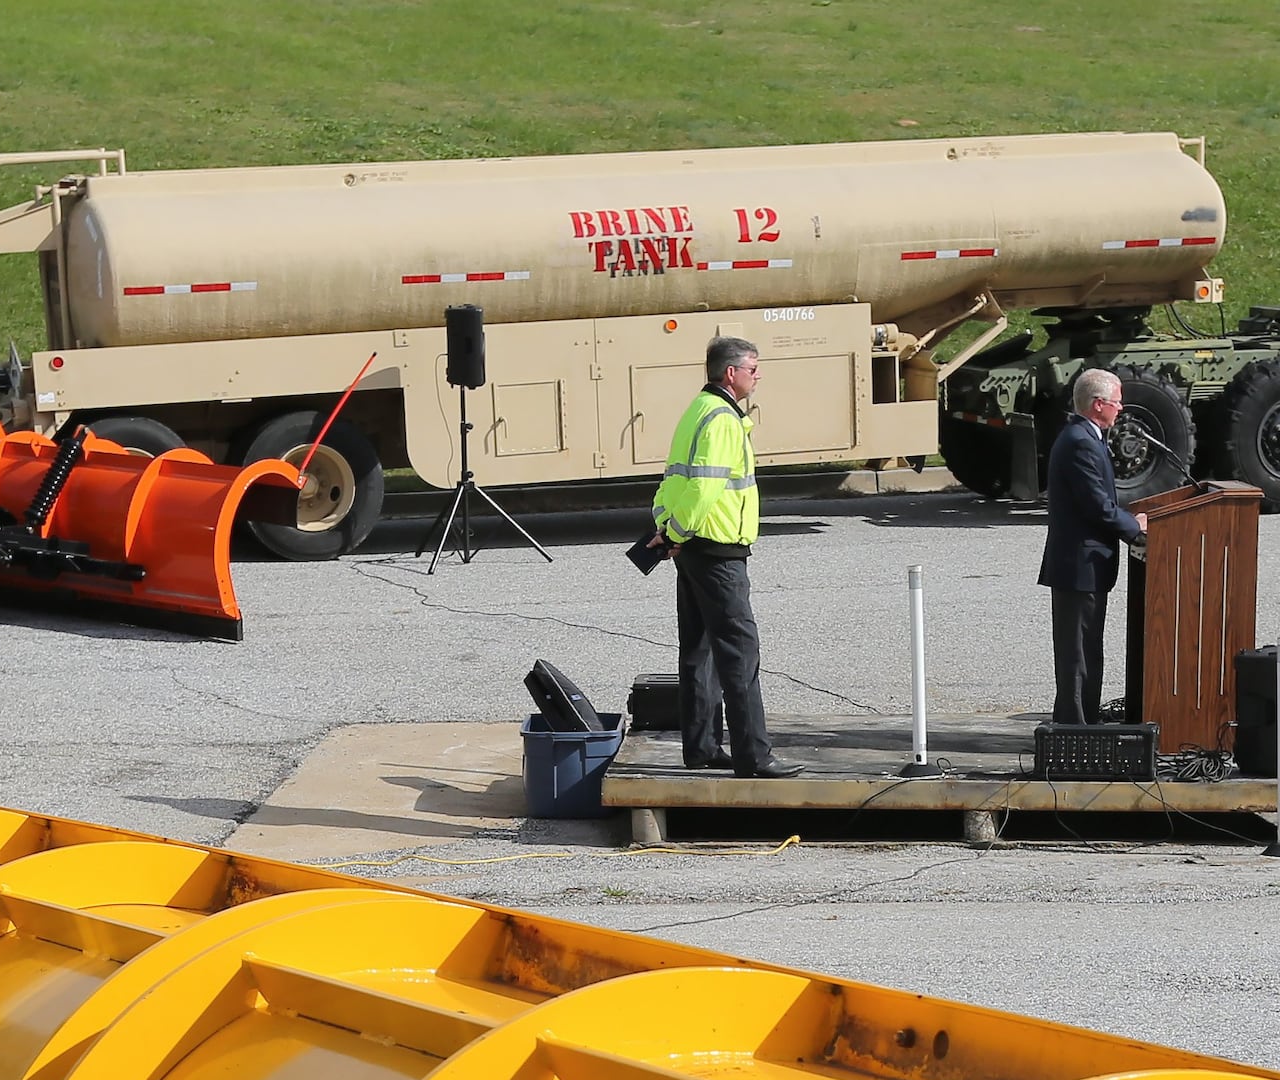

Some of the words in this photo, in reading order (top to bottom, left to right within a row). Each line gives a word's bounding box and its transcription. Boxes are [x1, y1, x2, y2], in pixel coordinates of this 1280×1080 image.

[568, 206, 694, 238] BRINE
[733, 207, 781, 243] 12
[588, 237, 694, 272] TANK
[763, 307, 815, 322] 0540766
